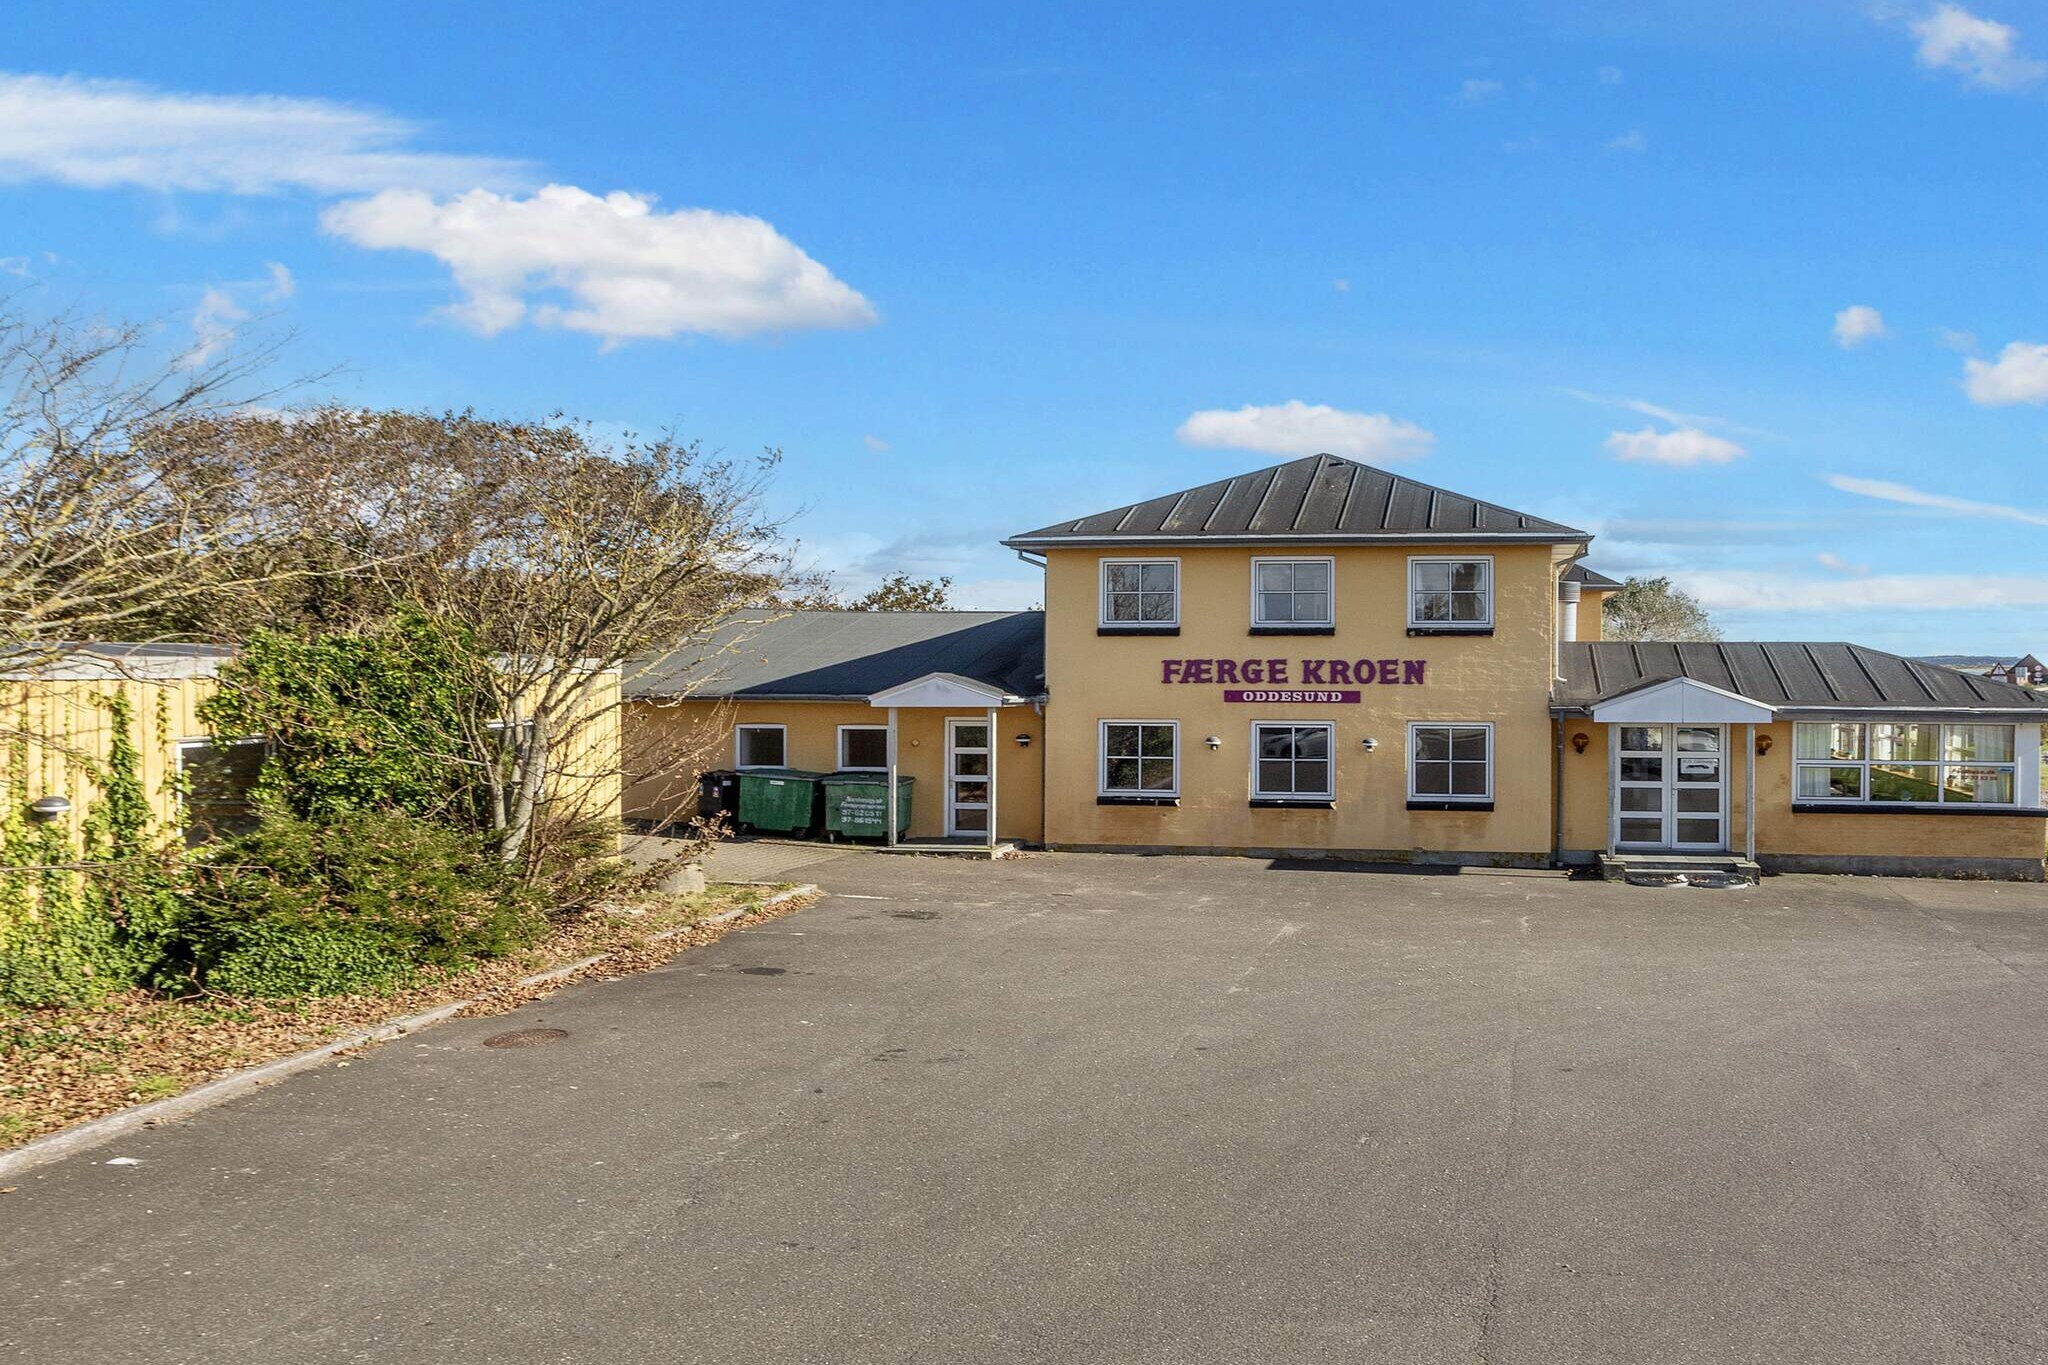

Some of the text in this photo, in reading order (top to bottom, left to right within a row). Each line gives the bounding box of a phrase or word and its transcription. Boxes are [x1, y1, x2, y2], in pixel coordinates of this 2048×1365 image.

[1161, 659, 1427, 684] FÆRGE KROEN
[1242, 691, 1343, 702] ODDESUND
